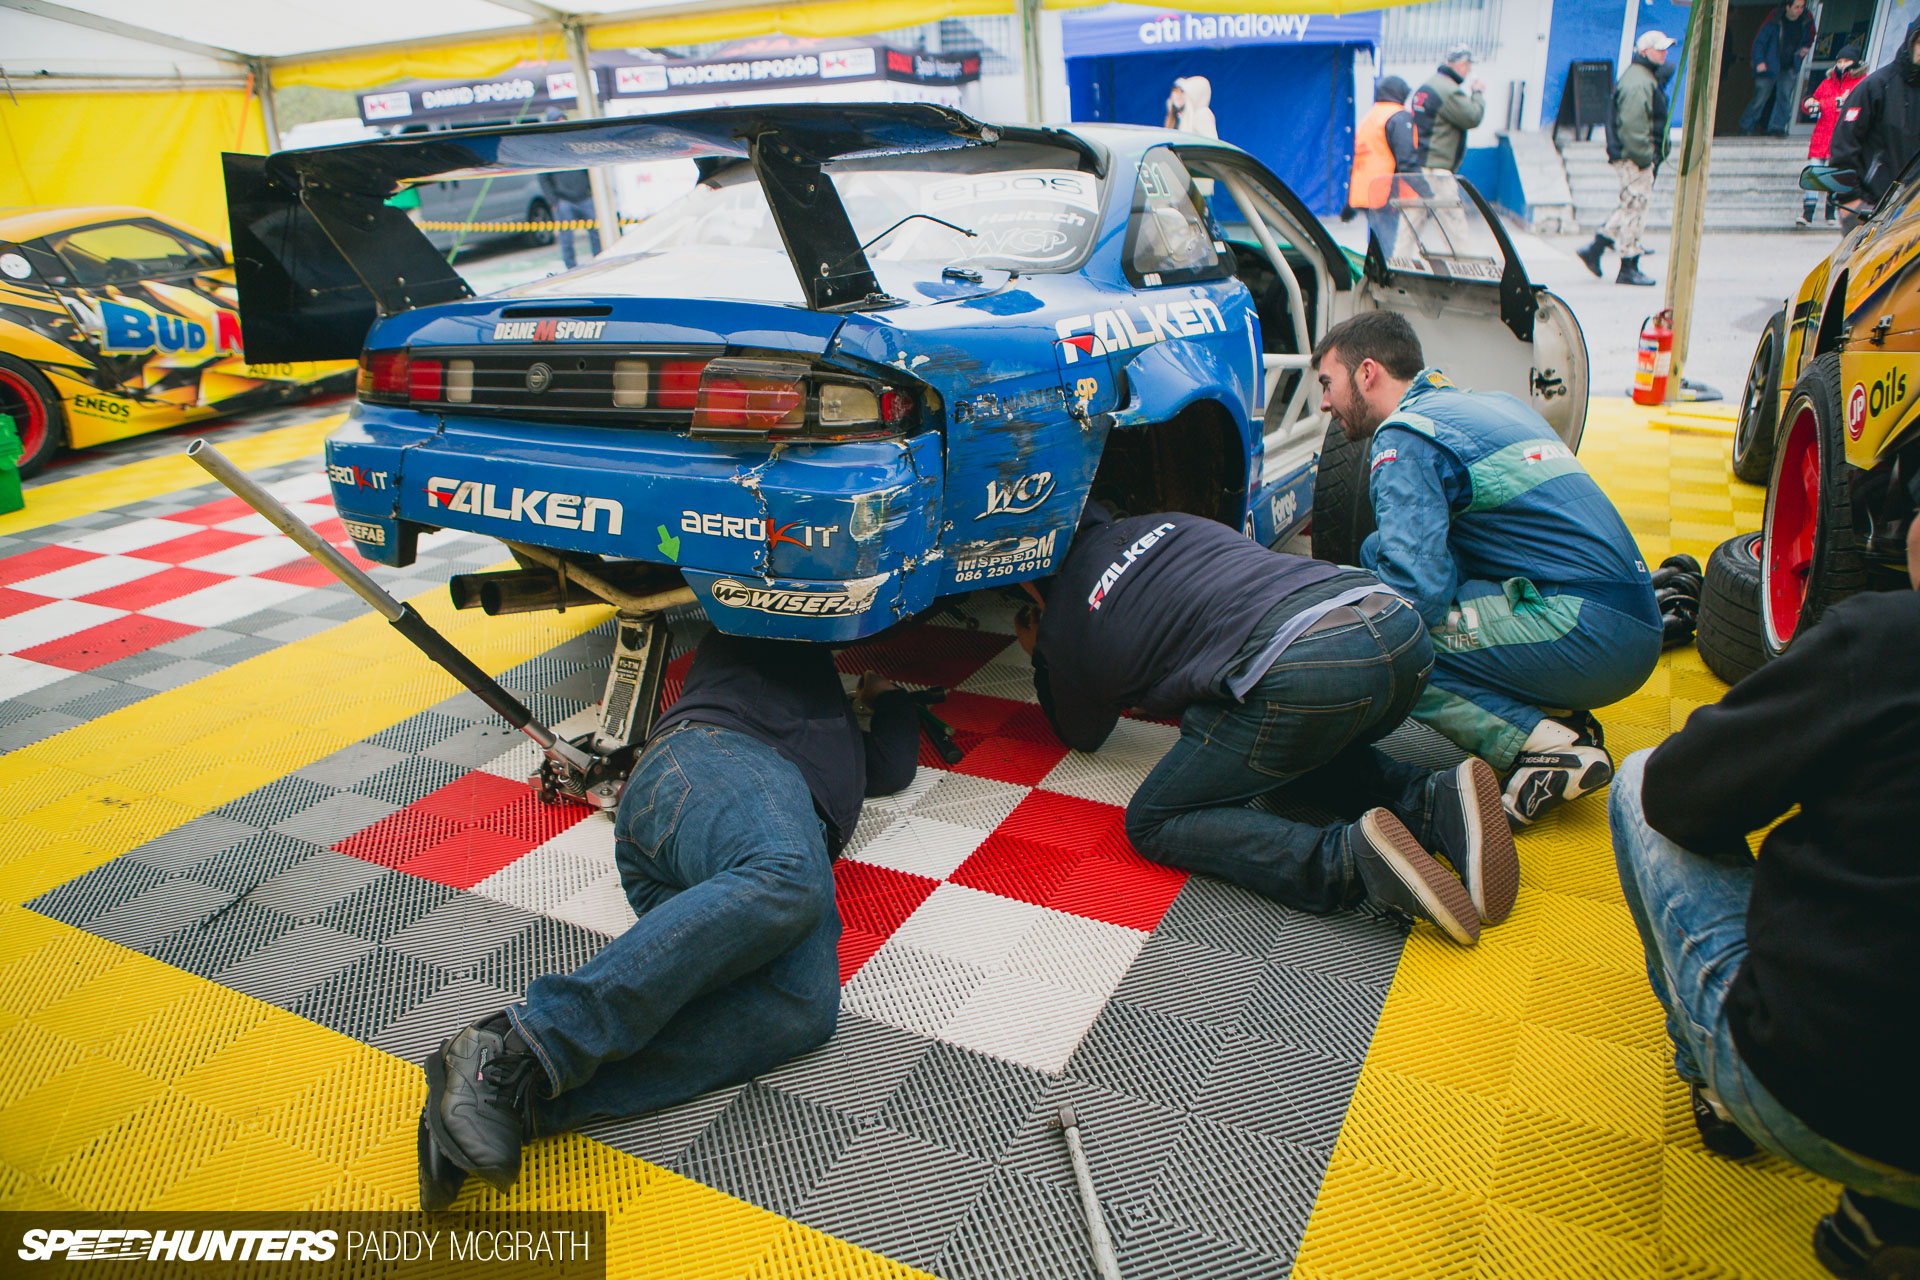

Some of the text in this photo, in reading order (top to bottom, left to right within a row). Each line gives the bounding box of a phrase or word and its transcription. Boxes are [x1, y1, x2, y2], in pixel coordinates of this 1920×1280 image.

[1139, 13, 1310, 43] citi handlowy
[1053, 298, 1227, 365] FALKEN
[74, 394, 130, 418] ENEOS
[1870, 366, 1907, 418] Oils
[328, 463, 388, 492] EROKIT
[983, 471, 1054, 517] WCP
[423, 476, 624, 536] FALKEN
[955, 558, 1051, 583] 086 250 4910
[1088, 522, 1176, 611] FALKEN
[1443, 631, 1479, 649] TIRE
